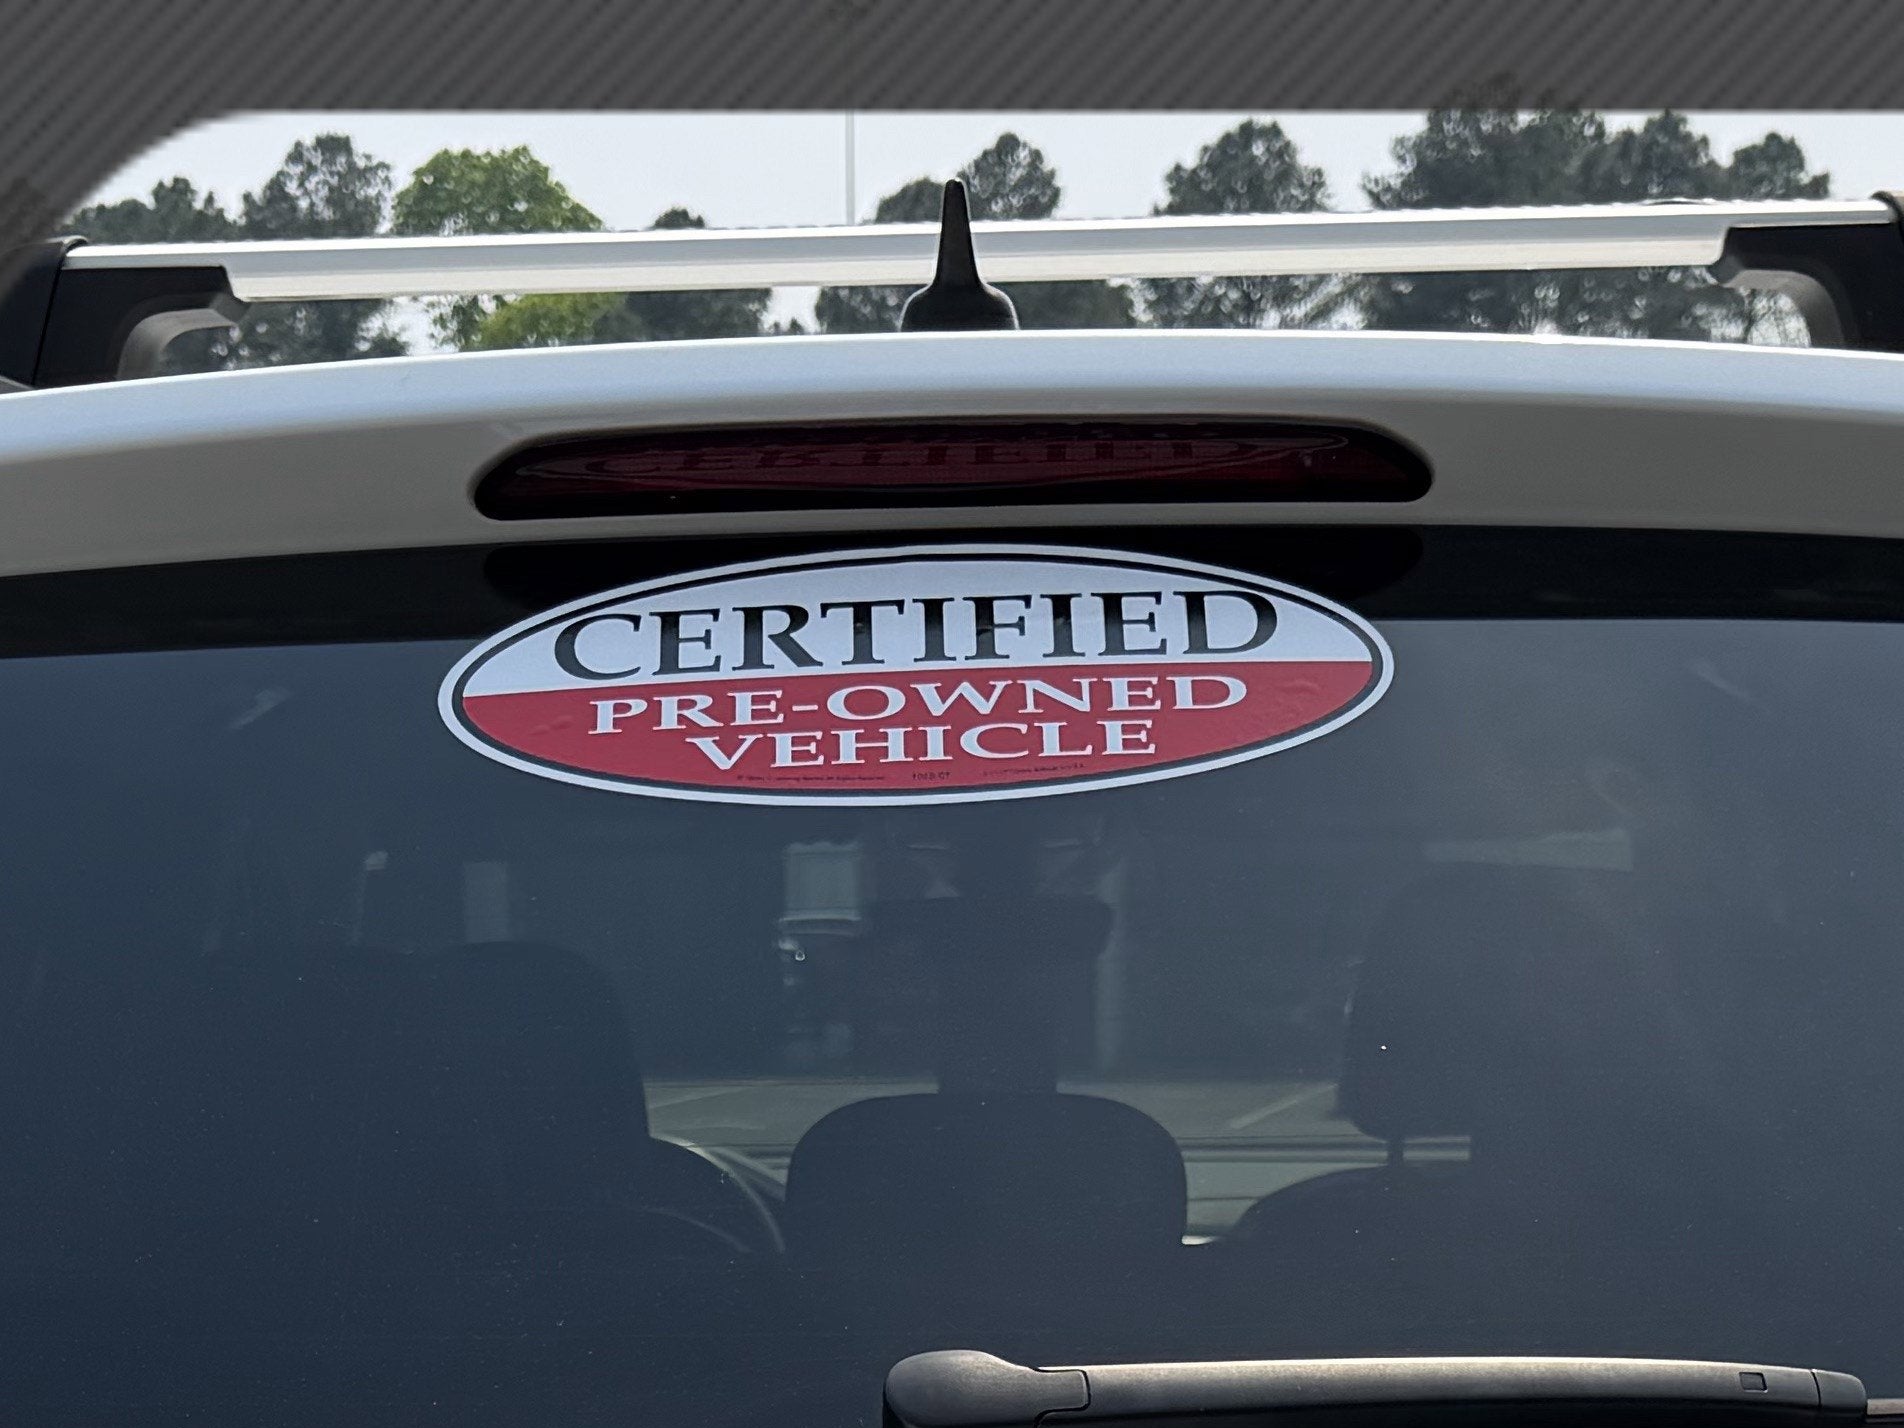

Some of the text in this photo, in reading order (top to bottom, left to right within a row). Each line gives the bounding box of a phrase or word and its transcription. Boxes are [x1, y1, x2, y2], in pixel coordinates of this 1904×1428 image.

[553, 589, 1279, 681] CERTIFIED
[589, 676, 1248, 735] PRE-OWNED
[686, 719, 1156, 771] VEHICLE
